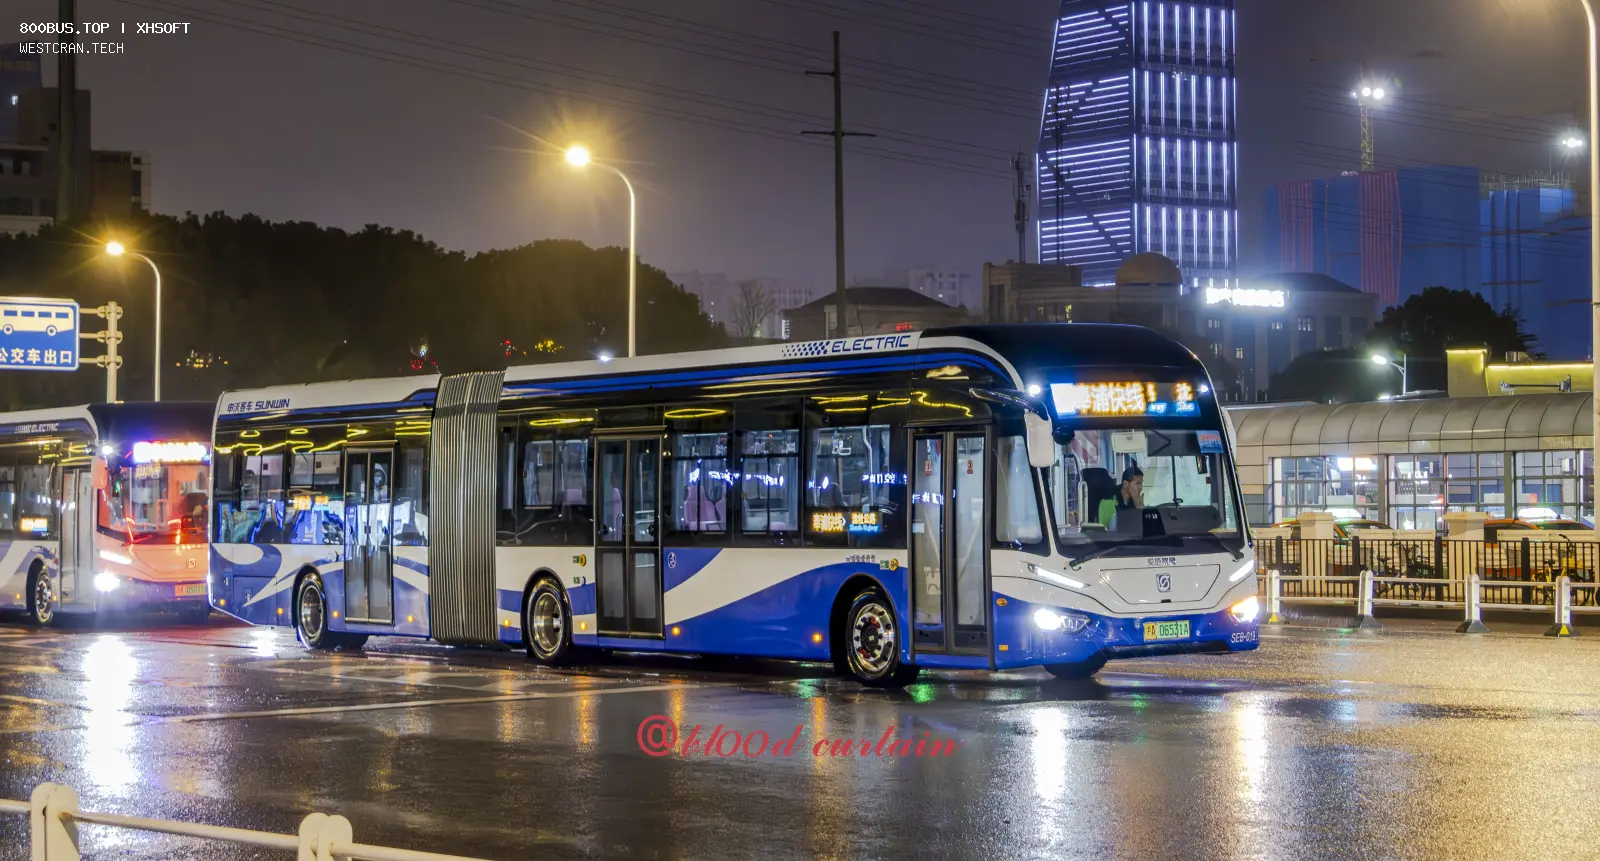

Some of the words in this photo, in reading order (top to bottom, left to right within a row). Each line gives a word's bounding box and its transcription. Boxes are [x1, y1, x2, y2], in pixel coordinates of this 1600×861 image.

[831, 335, 912, 353] ELECTRIC
[0, 347, 72, 365] 公交车出口
[255, 398, 290, 411] SUNWIN
